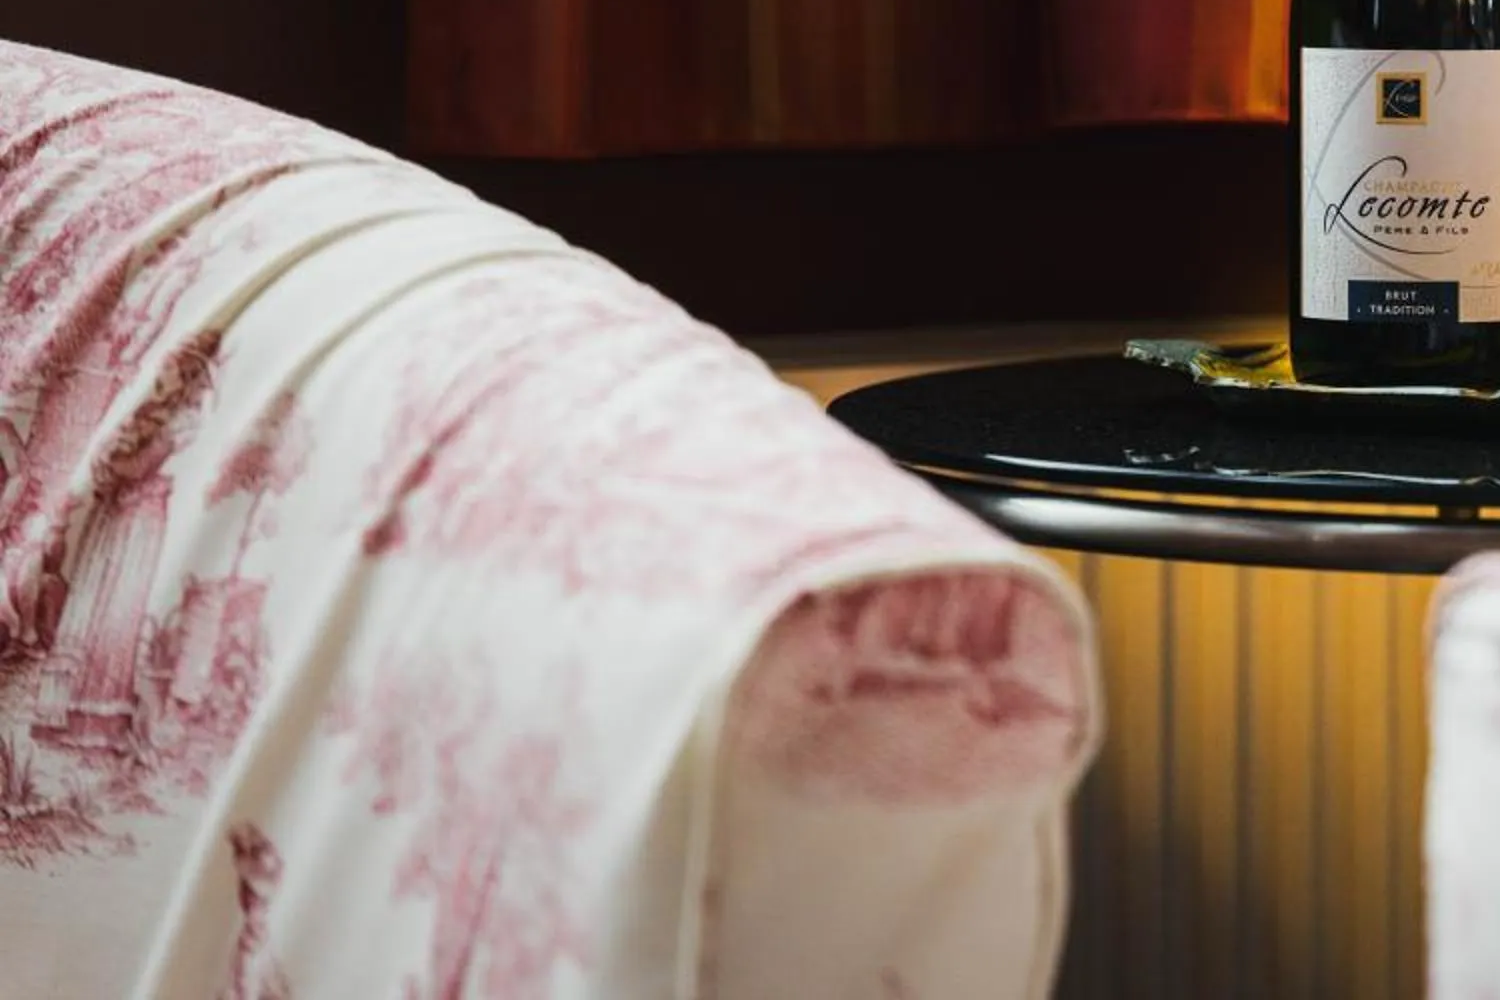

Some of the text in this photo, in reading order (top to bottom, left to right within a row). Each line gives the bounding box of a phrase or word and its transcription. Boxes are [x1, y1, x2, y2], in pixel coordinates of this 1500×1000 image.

[1364, 180, 1458, 193] CHAMPAG
[1324, 155, 1490, 256] Lecomte
[1385, 290, 1416, 301] BRUT
[1369, 304, 1435, 316] TRADITION
